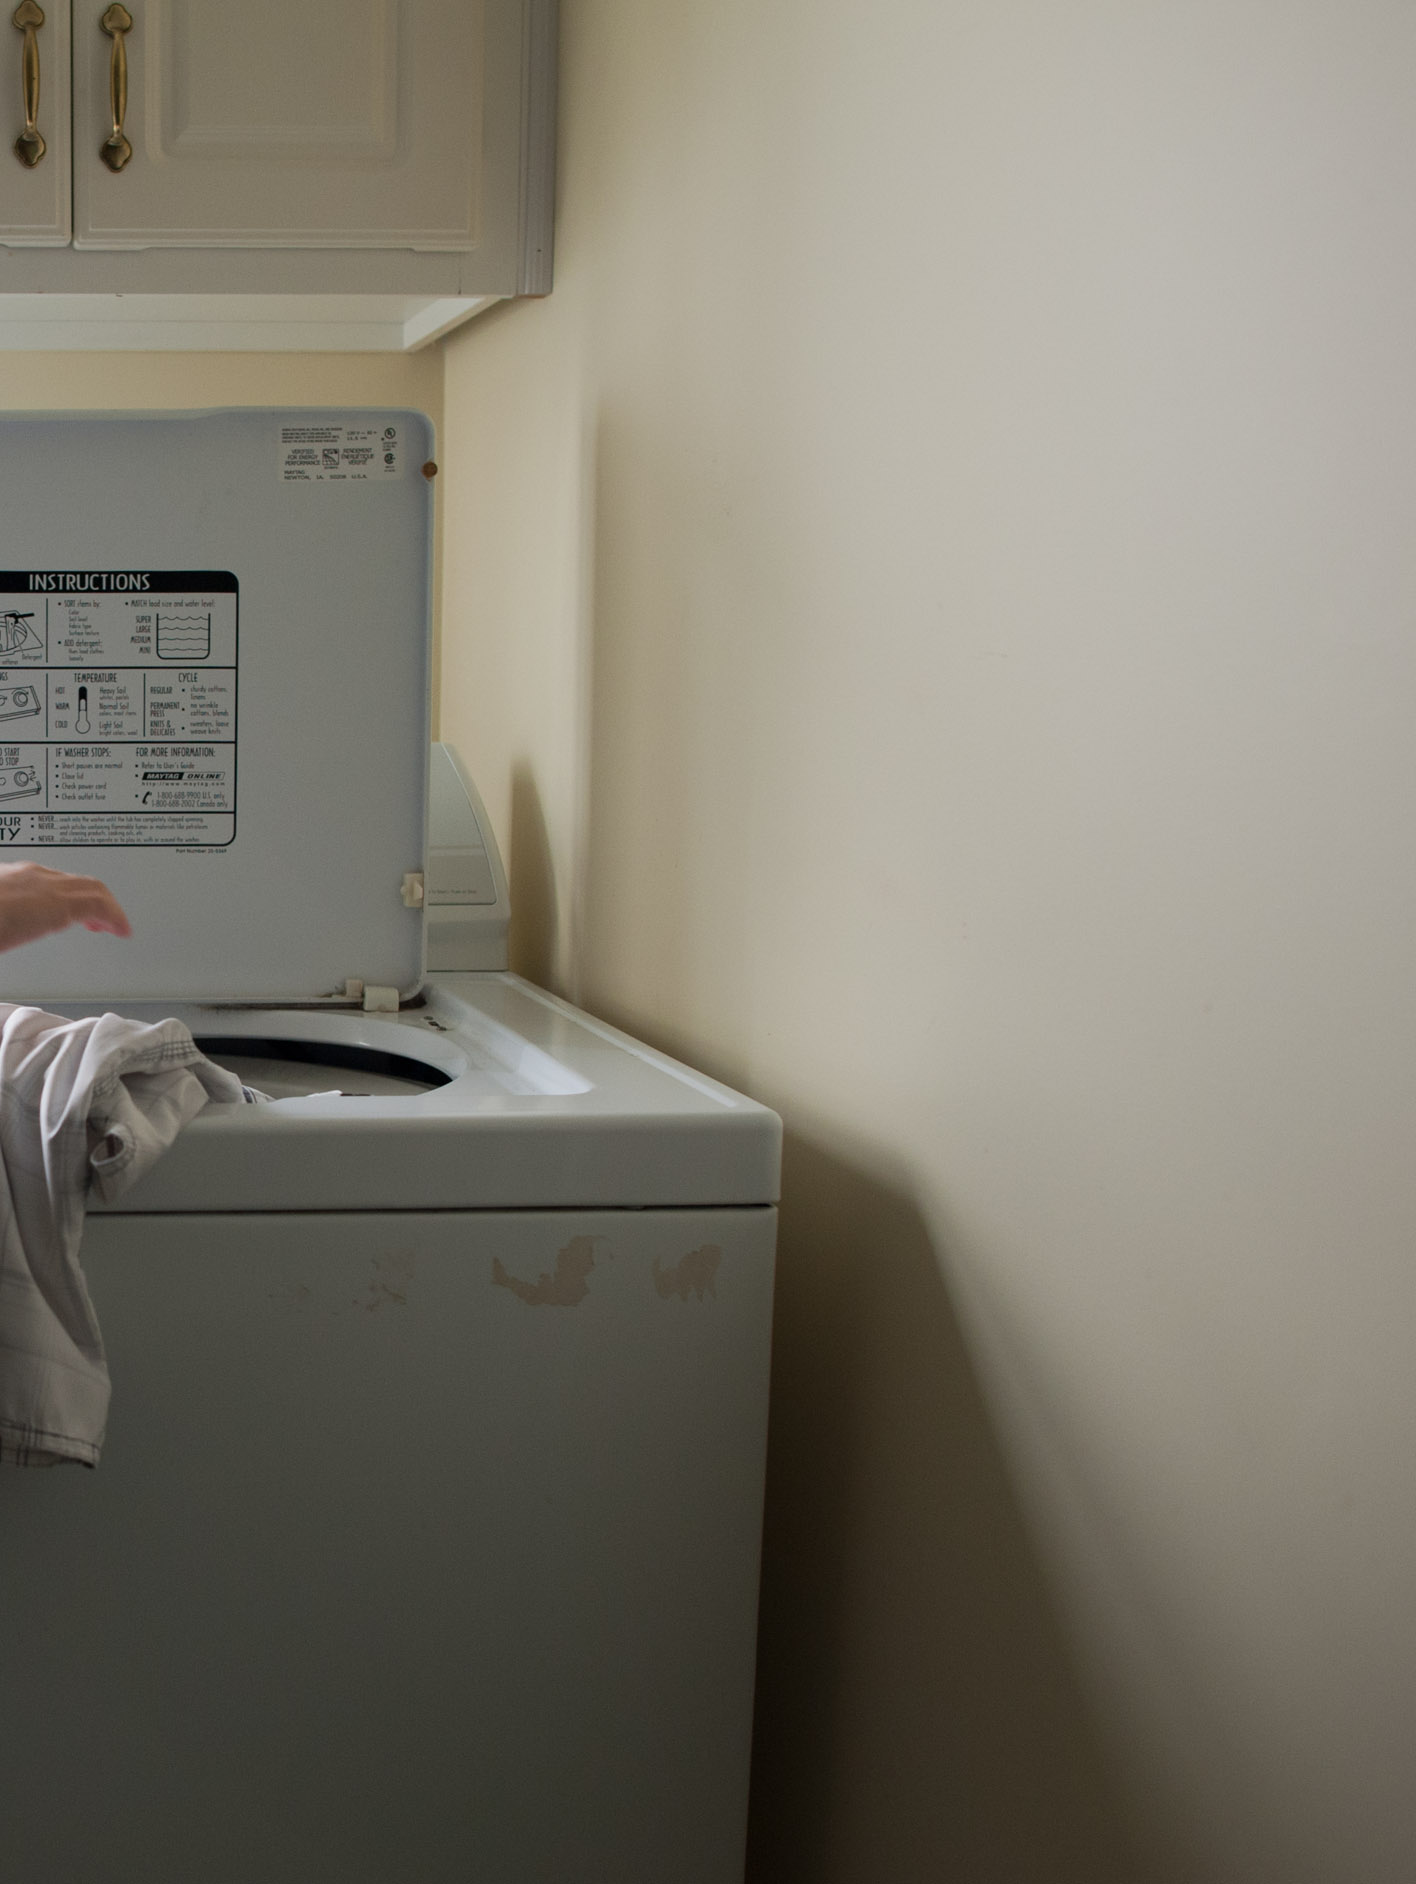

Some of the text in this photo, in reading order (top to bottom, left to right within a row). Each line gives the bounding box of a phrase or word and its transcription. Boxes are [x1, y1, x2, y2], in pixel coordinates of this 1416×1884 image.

[29, 573, 151, 590] INSTRUCTIONS
[74, 673, 117, 683] TEMPERATURE
[178, 672, 198, 683] CYCLE
[55, 720, 68, 728] COLD
[4, 747, 20, 756] START
[56, 747, 111, 757] IF WASHER STOPS:
[136, 747, 216, 757] FOR MORE INFORMATION:
[5, 757, 19, 766] STOP
[213, 791, 224, 800] only
[217, 799, 228, 808] only
